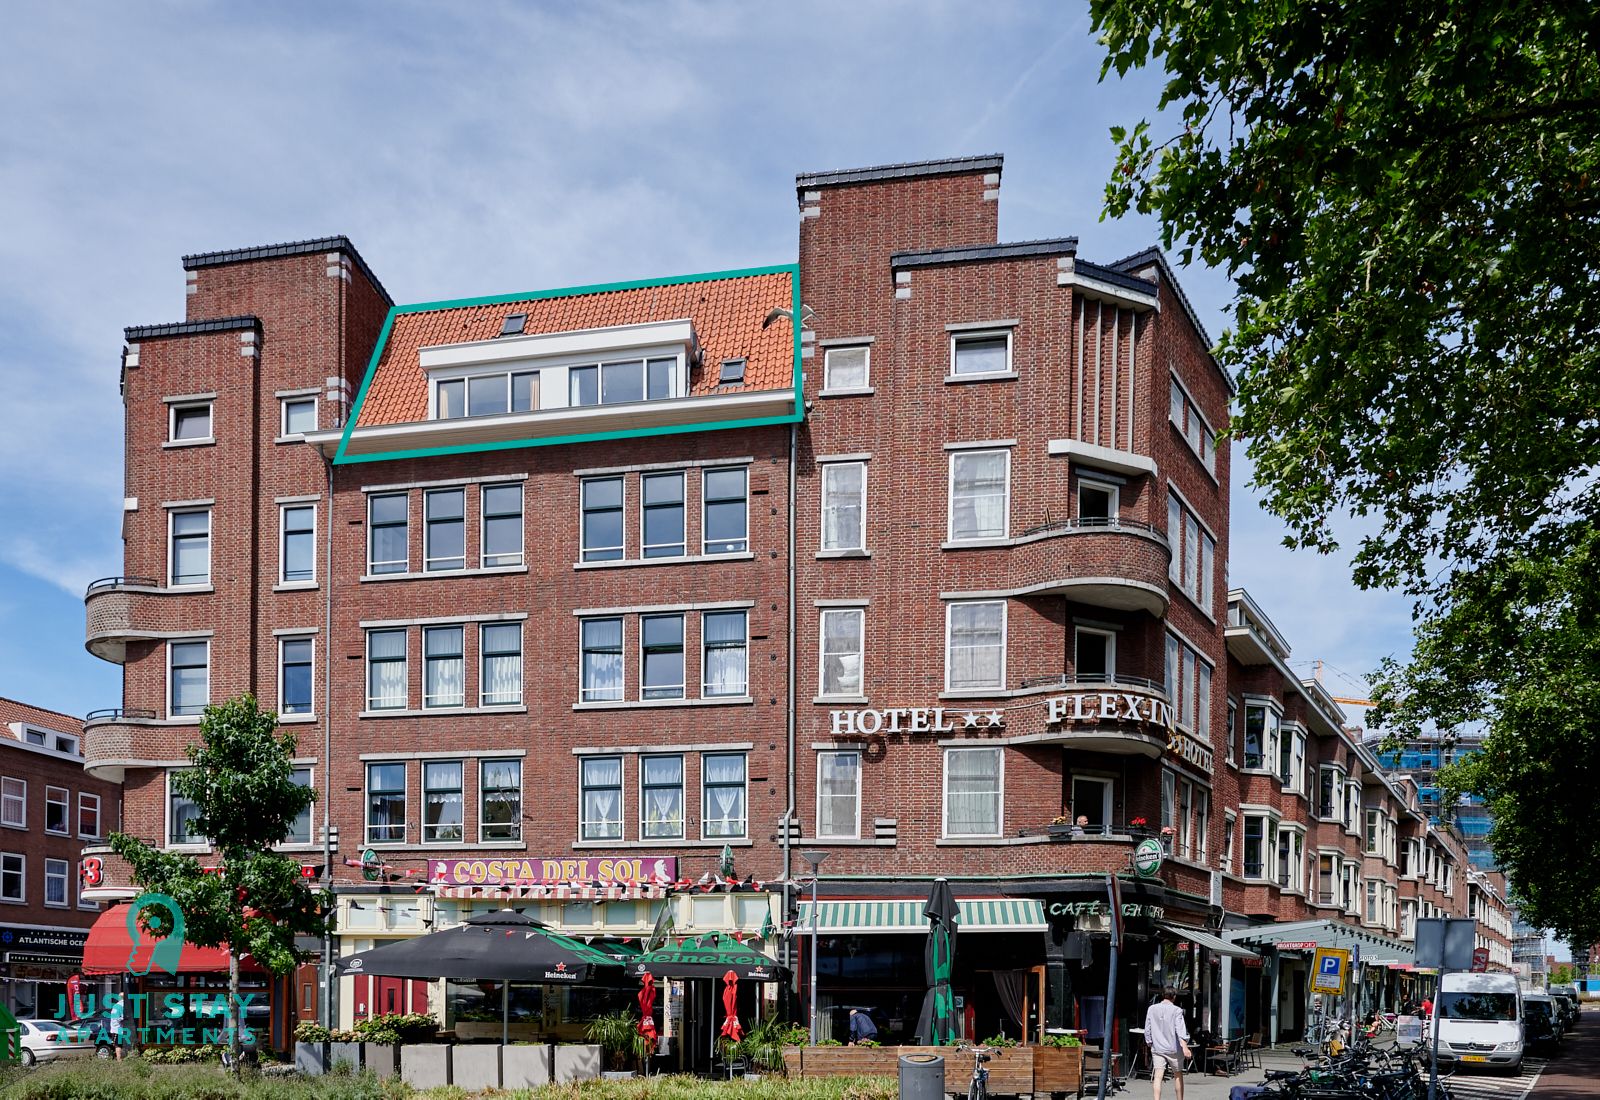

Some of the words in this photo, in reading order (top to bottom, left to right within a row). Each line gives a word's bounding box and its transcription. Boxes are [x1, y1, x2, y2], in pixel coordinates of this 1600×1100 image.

[829, 707, 954, 735] HOTEL
[1182, 735, 1215, 776] HOTEL
[453, 860, 536, 884] COSTA
[541, 860, 594, 883] DEL
[598, 859, 648, 883] SOL
[1049, 900, 1101, 916] CAFÉ
[19, 937, 68, 946] ATLANTISCHE
[632, 952, 770, 966] Heineken
[1324, 958, 1336, 973] P
[545, 971, 577, 979] Heineken
